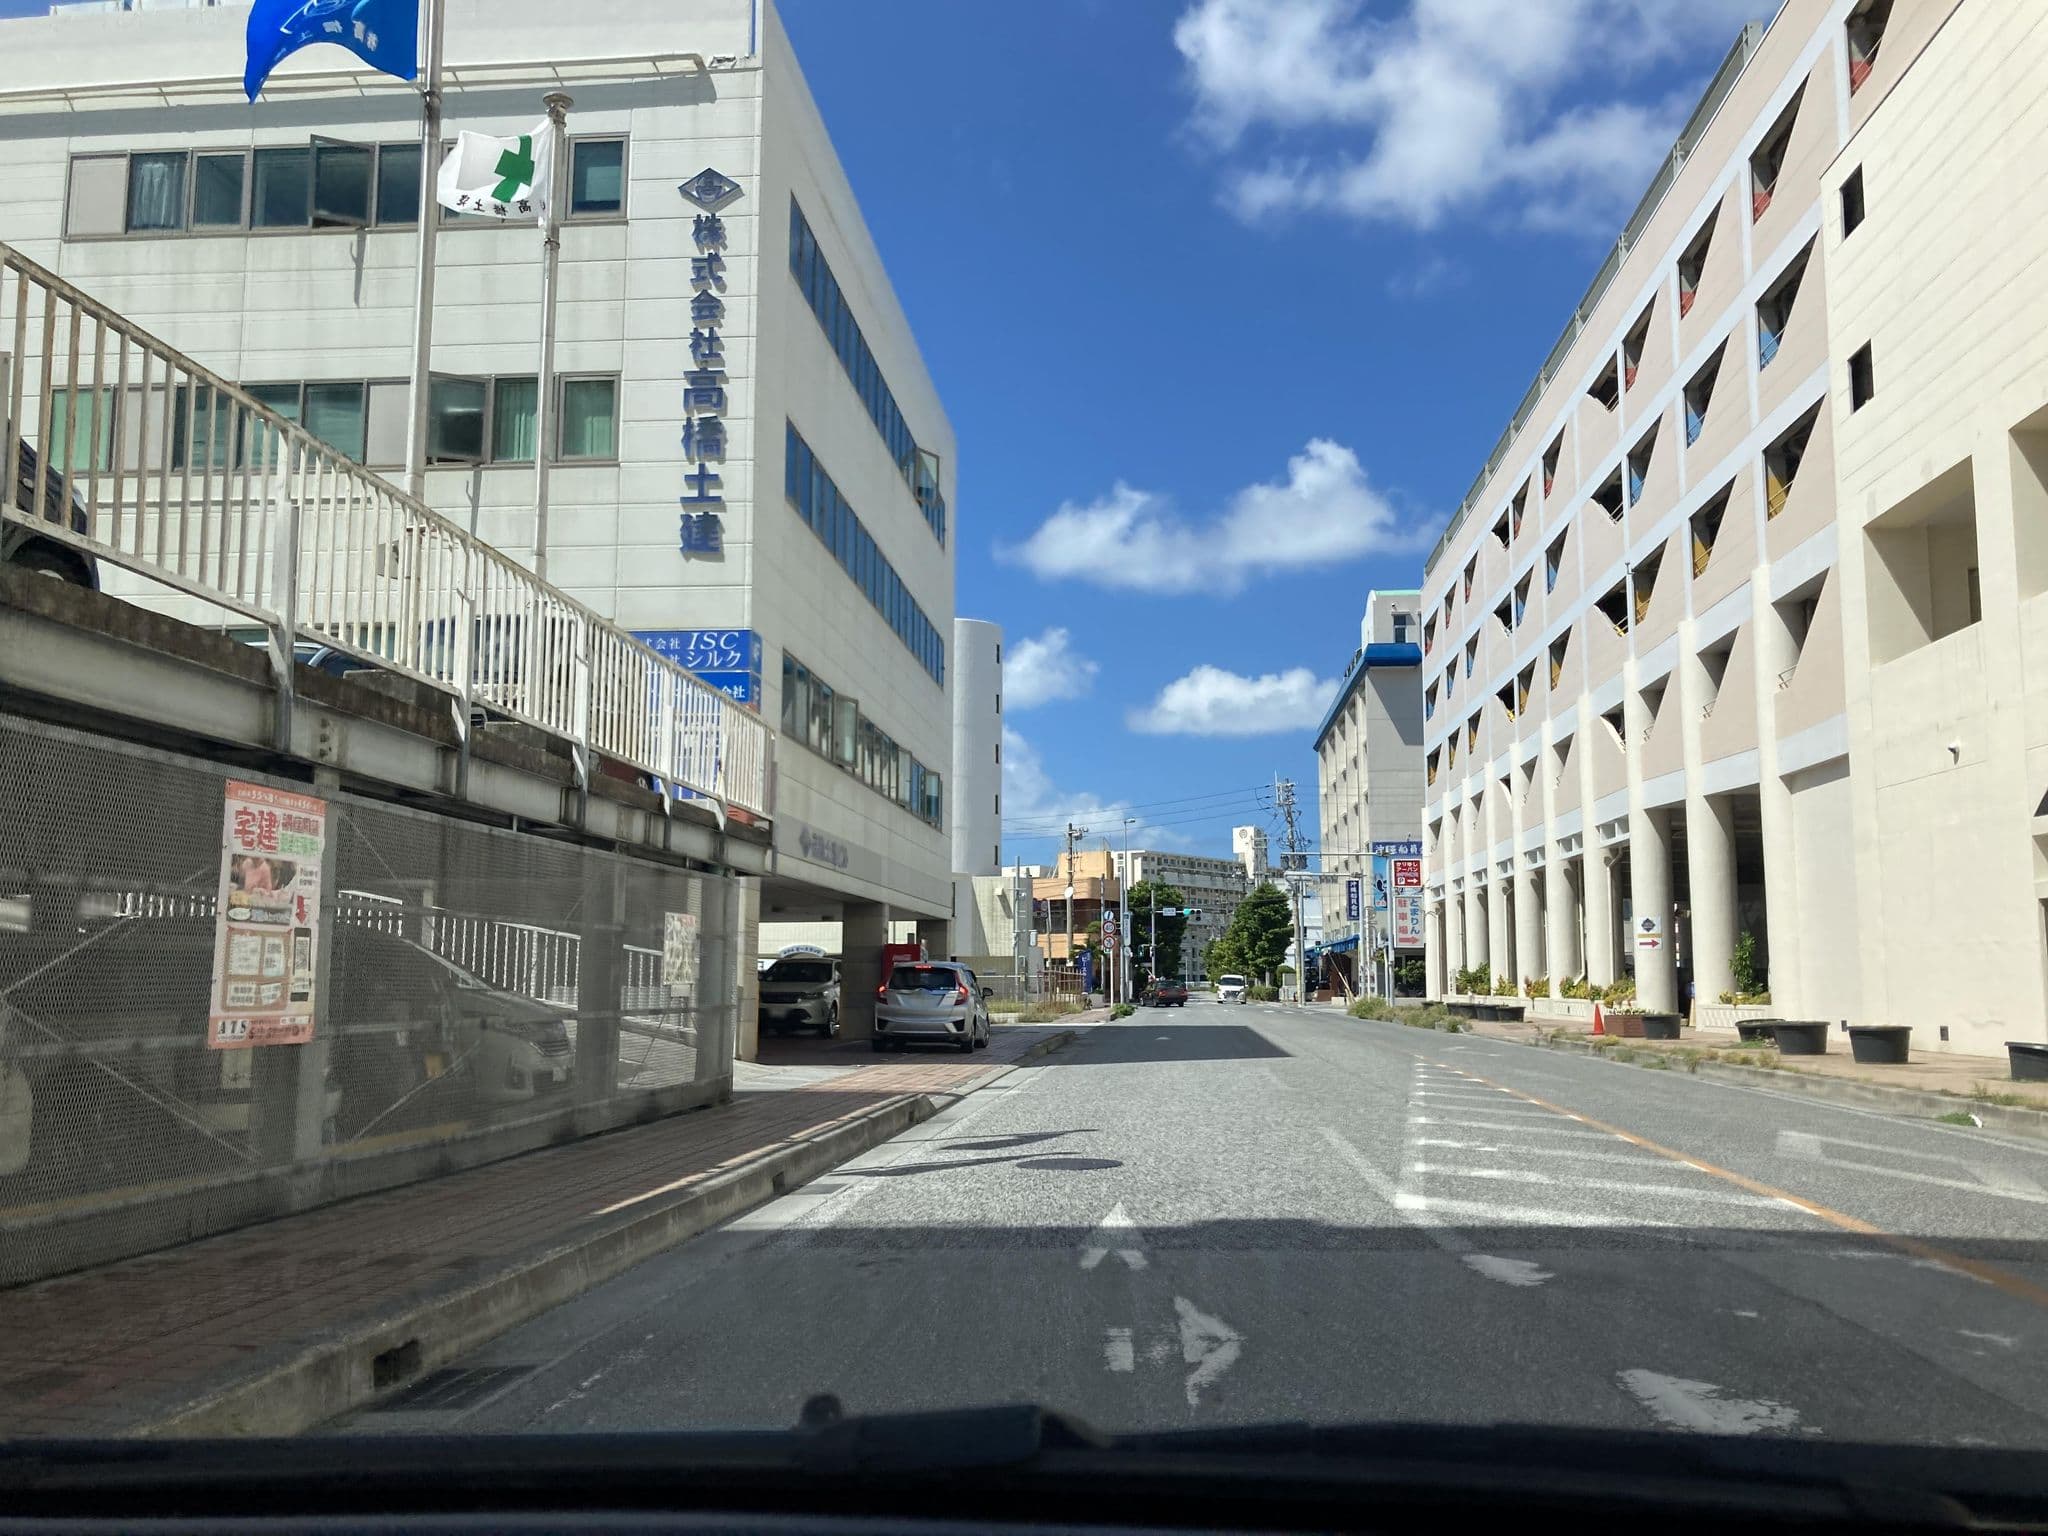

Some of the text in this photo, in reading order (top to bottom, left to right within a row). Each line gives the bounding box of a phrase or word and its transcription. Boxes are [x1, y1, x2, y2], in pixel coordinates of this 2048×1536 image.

[680, 213, 725, 552] 株式会社高橋土建
[687, 651, 741, 668] シルク
[1398, 898, 1408, 934] 駐車場
[1410, 898, 1420, 935] とまりん
